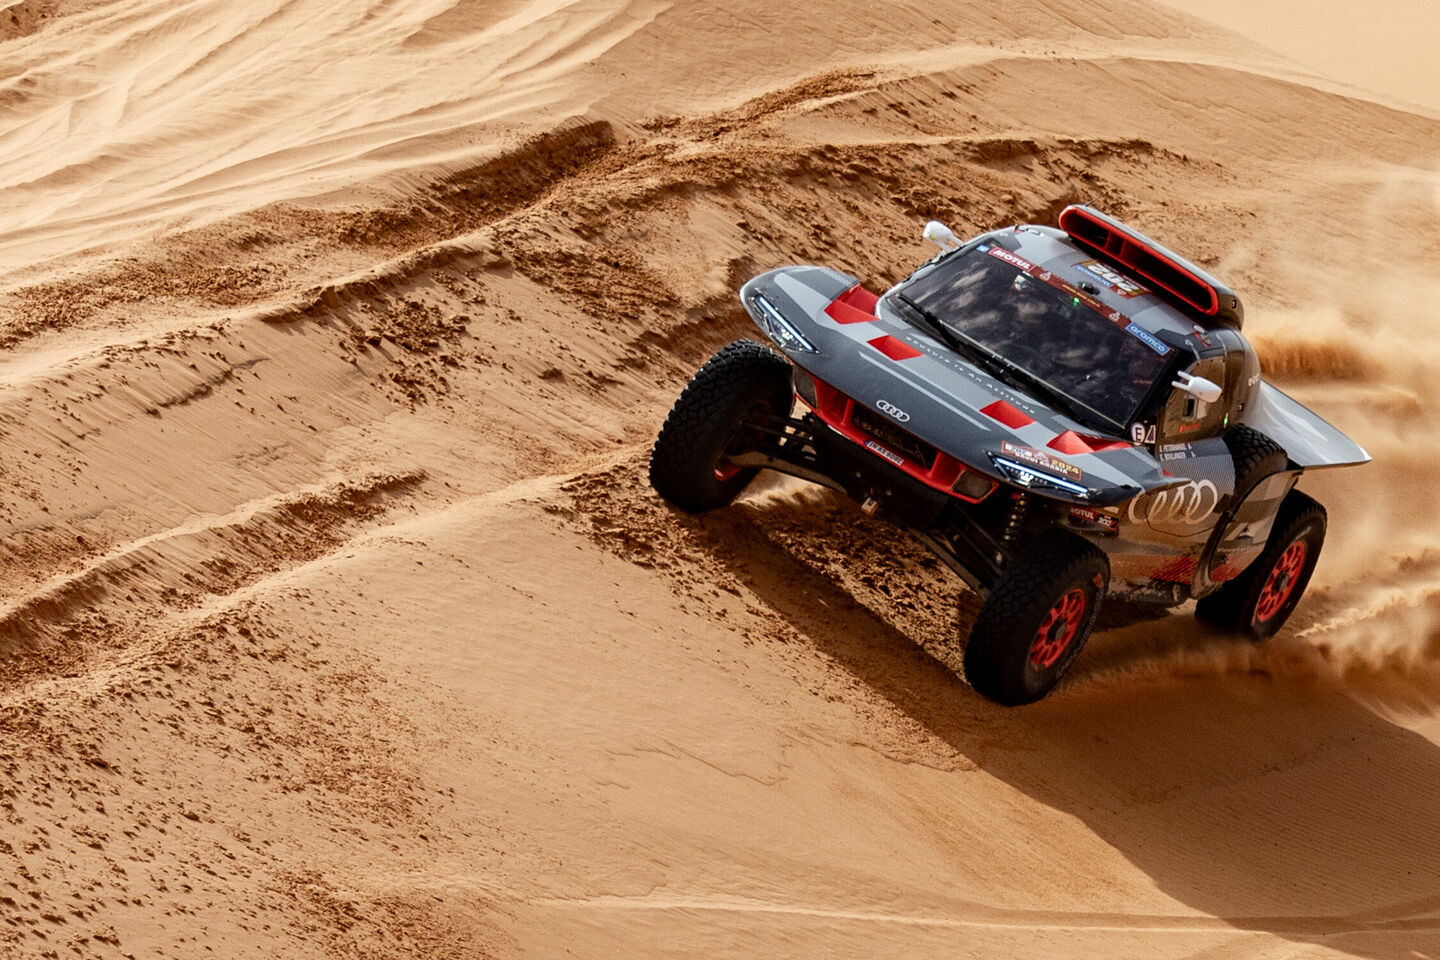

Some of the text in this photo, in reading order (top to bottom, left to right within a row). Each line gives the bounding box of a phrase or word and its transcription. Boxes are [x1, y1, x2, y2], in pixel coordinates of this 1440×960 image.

[994, 249, 1031, 270] MOTUL
[1130, 325, 1165, 352] aramco
[1051, 459, 1079, 475] 2024
